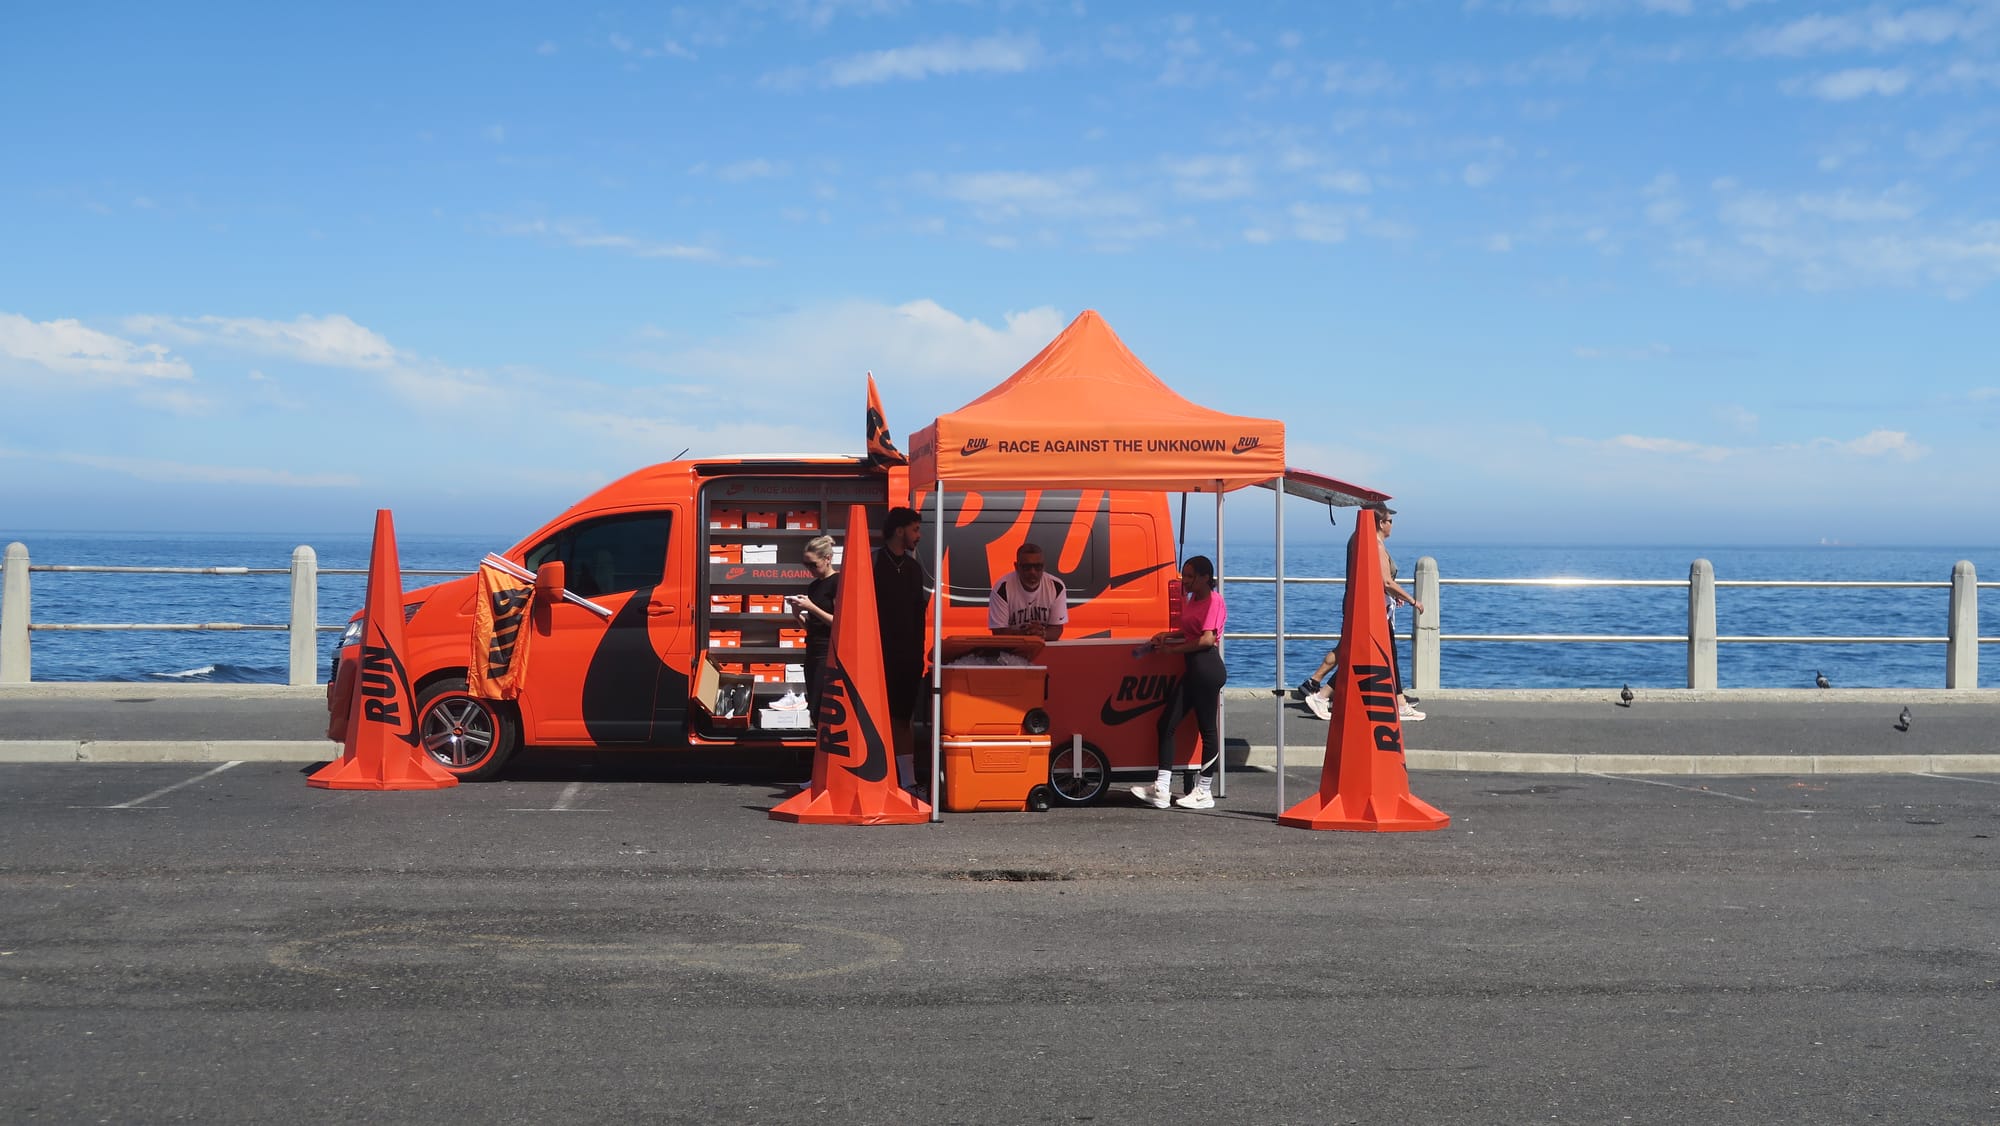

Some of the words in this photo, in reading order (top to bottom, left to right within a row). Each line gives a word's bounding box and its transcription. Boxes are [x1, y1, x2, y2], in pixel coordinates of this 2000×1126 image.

[966, 437, 989, 449] RUN
[998, 440, 1040, 453] RACE
[1043, 439, 1110, 453] AGAINST
[1113, 439, 1143, 452] THE
[1147, 439, 1226, 452] UNKNOWN
[1238, 436, 1259, 447] RUN
[752, 569, 779, 578] RACE
[1008, 606, 1051, 626] ATLANT
[361, 646, 402, 726] RUN
[1116, 674, 1178, 702] RUN
[818, 667, 851, 758] RUN
[1352, 665, 1402, 754] RUN
